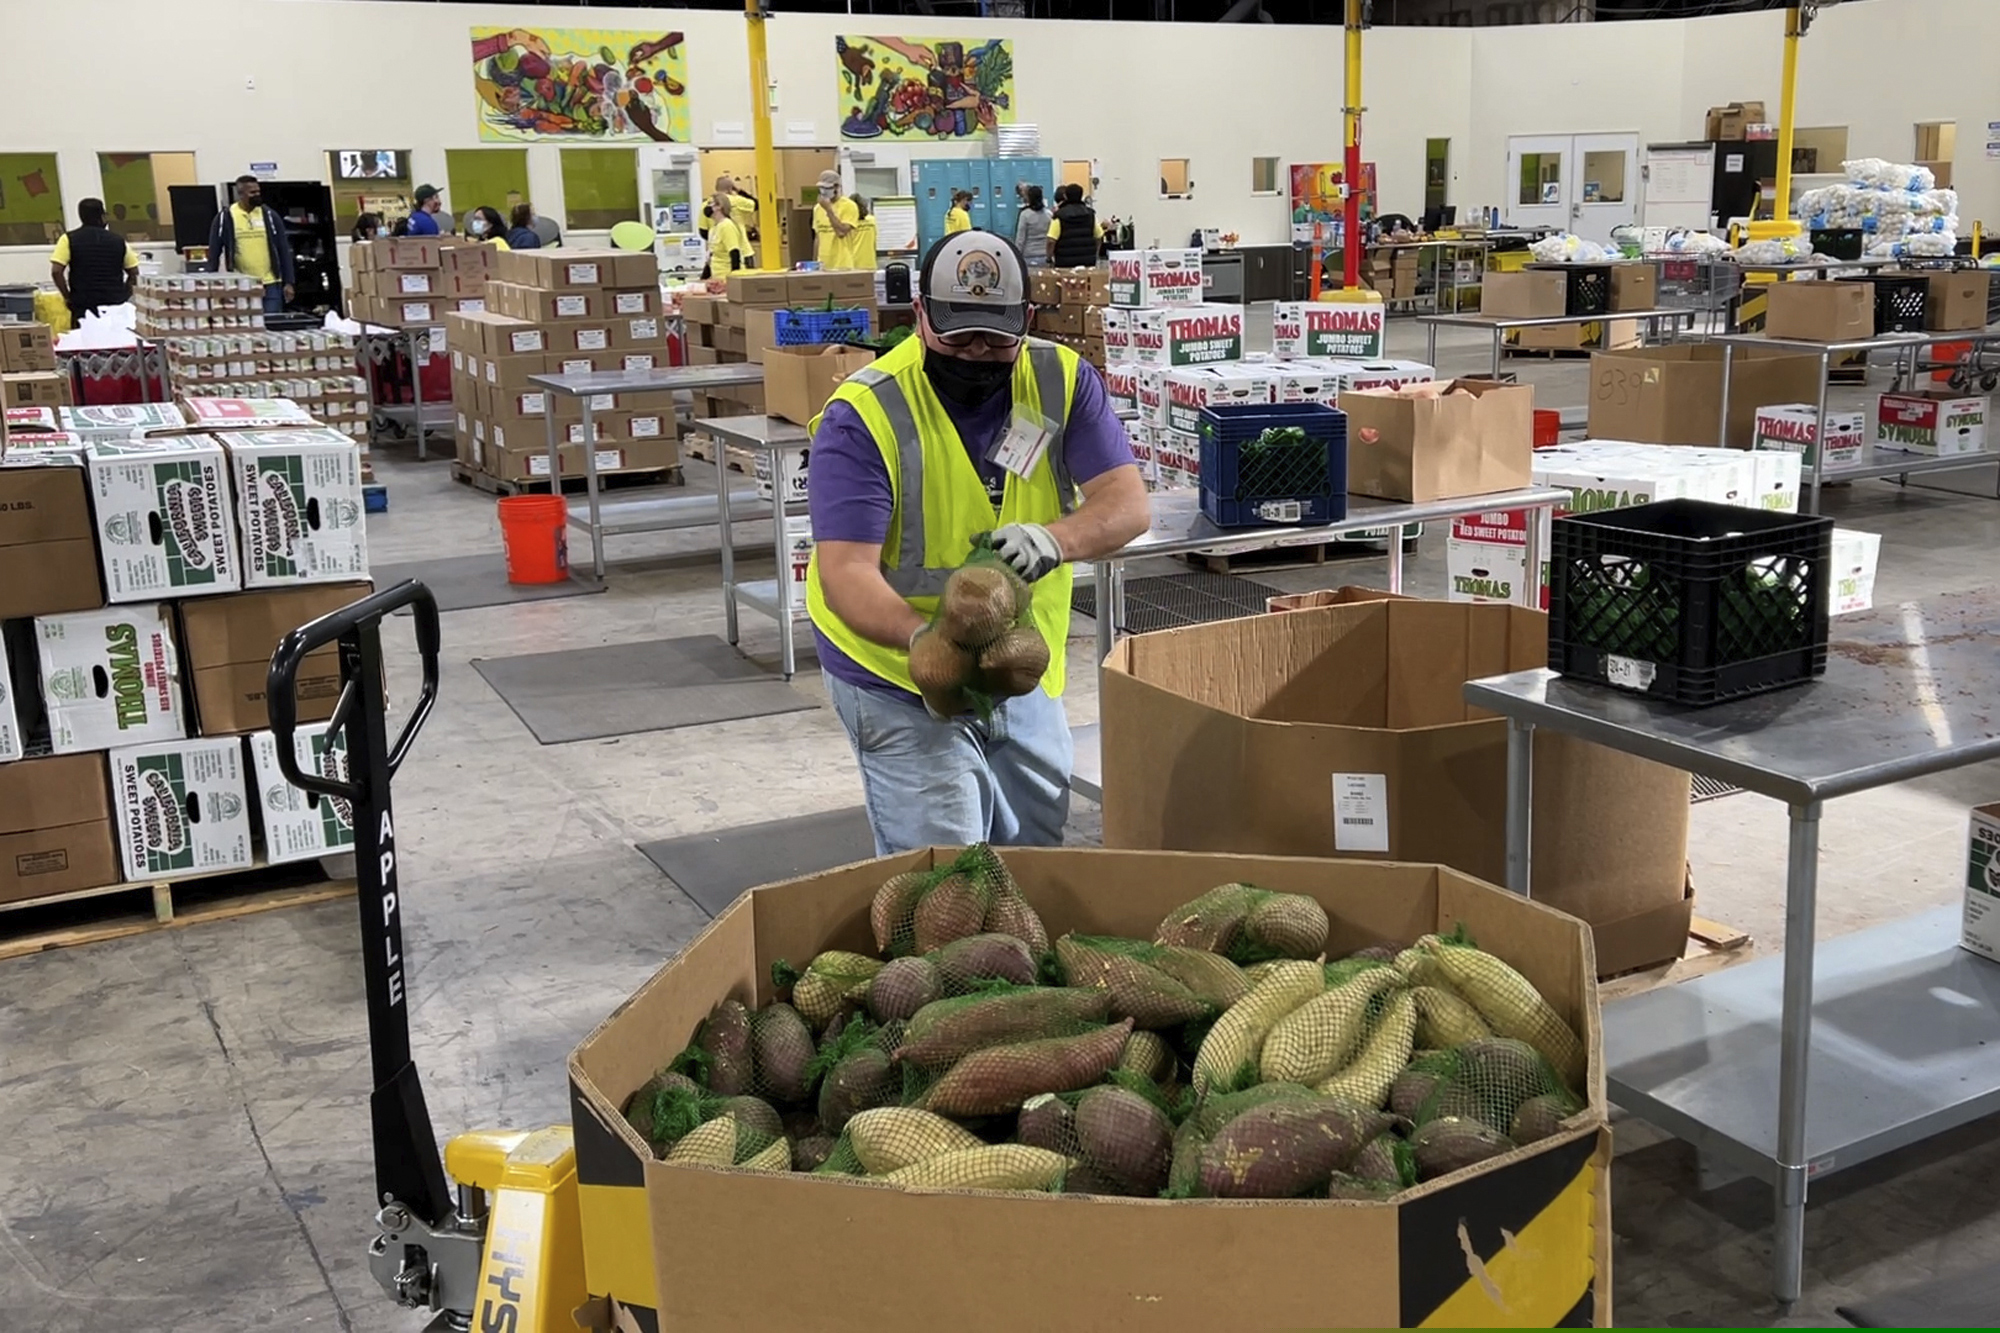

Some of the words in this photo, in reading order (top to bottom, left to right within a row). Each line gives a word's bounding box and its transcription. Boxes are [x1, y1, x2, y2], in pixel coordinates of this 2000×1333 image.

[1110, 260, 1141, 281] THOMAS
[1148, 271, 1200, 288] THOMAS
[1167, 315, 1240, 341] THOMAS
[1274, 323, 1300, 339] THOMAS
[1305, 311, 1381, 332] THOMAS
[1133, 333, 1163, 349] THOMAS
[1179, 340, 1208, 354] JUMBO
[1209, 338, 1234, 350] SWEET
[1316, 333, 1346, 344] JUMBO
[1347, 335, 1373, 345] SWEET
[1326, 344, 1364, 354] POTATOES
[1189, 349, 1226, 363] POTATOES
[1164, 380, 1207, 408] THOMAS
[1757, 415, 1817, 444] THOMAS
[1824, 433, 1862, 450] THOMAS
[1878, 423, 1938, 447] THOMAS
[203, 465, 221, 530] POTATOES
[245, 464, 259, 506] SWEET
[166, 482, 207, 567] CALIFORNIA
[188, 487, 209, 542] SWEETS
[1480, 512, 1509, 526] JUMBO
[250, 510, 265, 572] POTATOES
[1460, 525, 1473, 536] RED
[1474, 526, 1497, 539] SWEET
[212, 532, 227, 575] SWEET
[1454, 575, 1511, 599] THOMAS
[151, 633, 166, 670] POTATOES
[106, 623, 148, 730] THOMAS
[144, 661, 157, 688] JUMBO
[156, 672, 169, 696] SWEET
[159, 697, 170, 712] RED
[125, 764, 139, 805] SWEET
[142, 796, 162, 848] SWEETS
[146, 772, 183, 852] CALIFORNIA
[130, 809, 147, 869] POTATOES
[379, 809, 402, 1007] APPLE
